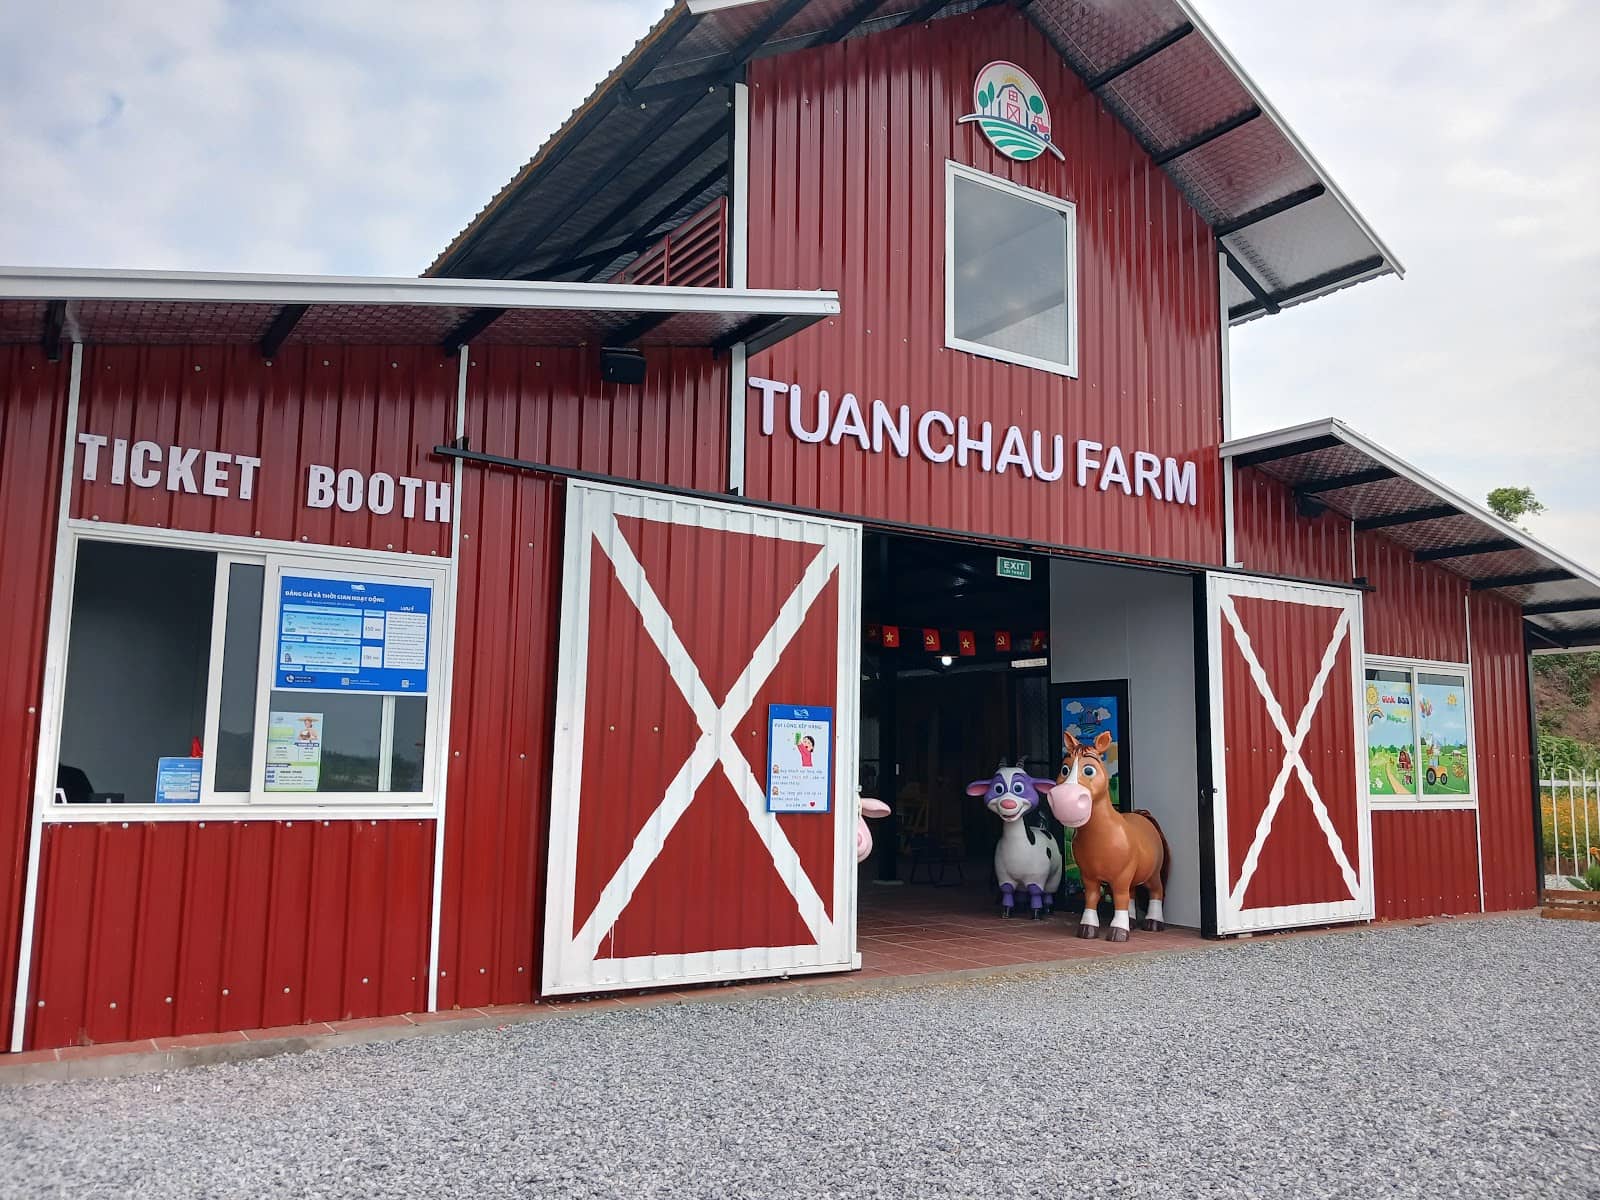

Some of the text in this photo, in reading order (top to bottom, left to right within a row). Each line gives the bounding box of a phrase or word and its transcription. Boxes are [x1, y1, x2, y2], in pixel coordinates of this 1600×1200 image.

[78, 433, 451, 523] TICKET BOOTH
[748, 376, 1197, 506] TUAN CHAU FARM
[1003, 560, 1025, 571] EXIT
